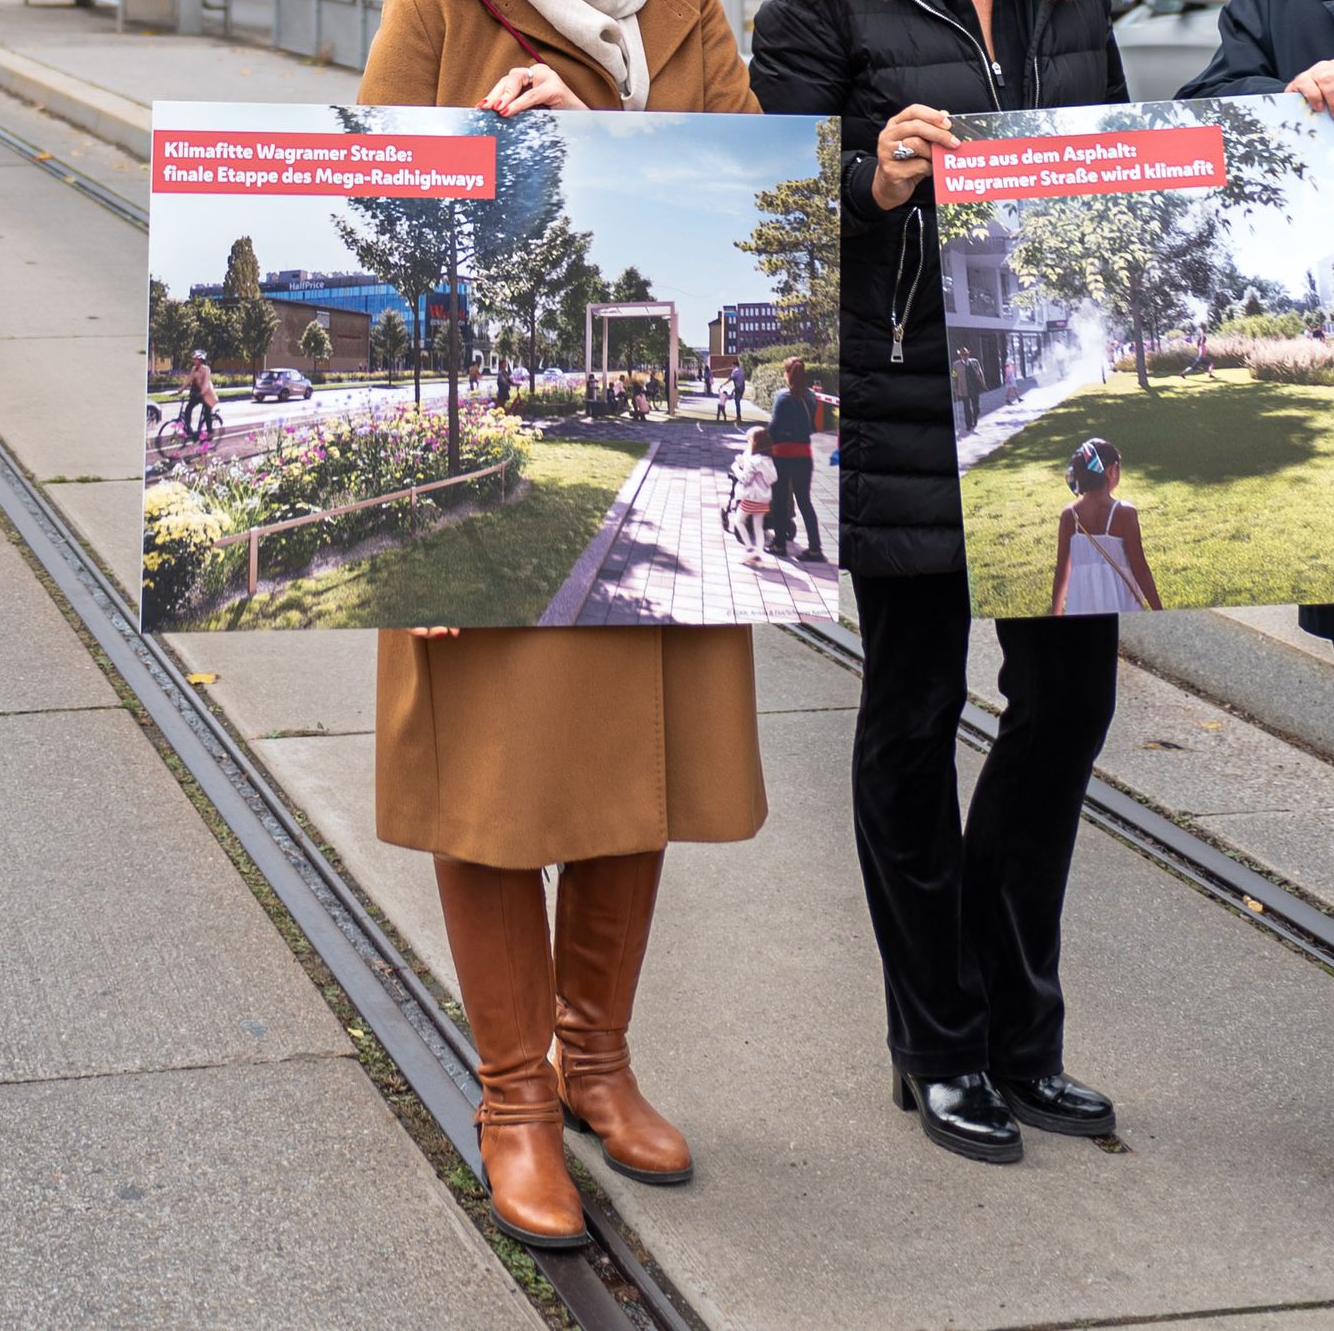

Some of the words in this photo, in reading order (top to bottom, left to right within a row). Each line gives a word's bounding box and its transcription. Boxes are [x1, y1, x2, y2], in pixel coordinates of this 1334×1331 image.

[164, 141, 253, 160] Klimafitte
[256, 143, 347, 165] Wagramer
[350, 144, 413, 163] Straße:
[944, 154, 987, 170] Raus
[988, 152, 1018, 167] aus
[1021, 149, 1060, 165] dem
[1063, 143, 1137, 166] Asphalt:
[163, 165, 214, 183] finale
[217, 166, 278, 188] Etappe
[281, 167, 312, 184] des
[315, 167, 484, 191] Mega-Radhighways
[945, 172, 1036, 195] Wagramer
[1040, 167, 1098, 187] Straße
[1100, 164, 1142, 182] wird
[1144, 159, 1215, 180] klimafit
[289, 280, 325, 291] HalfPrice
